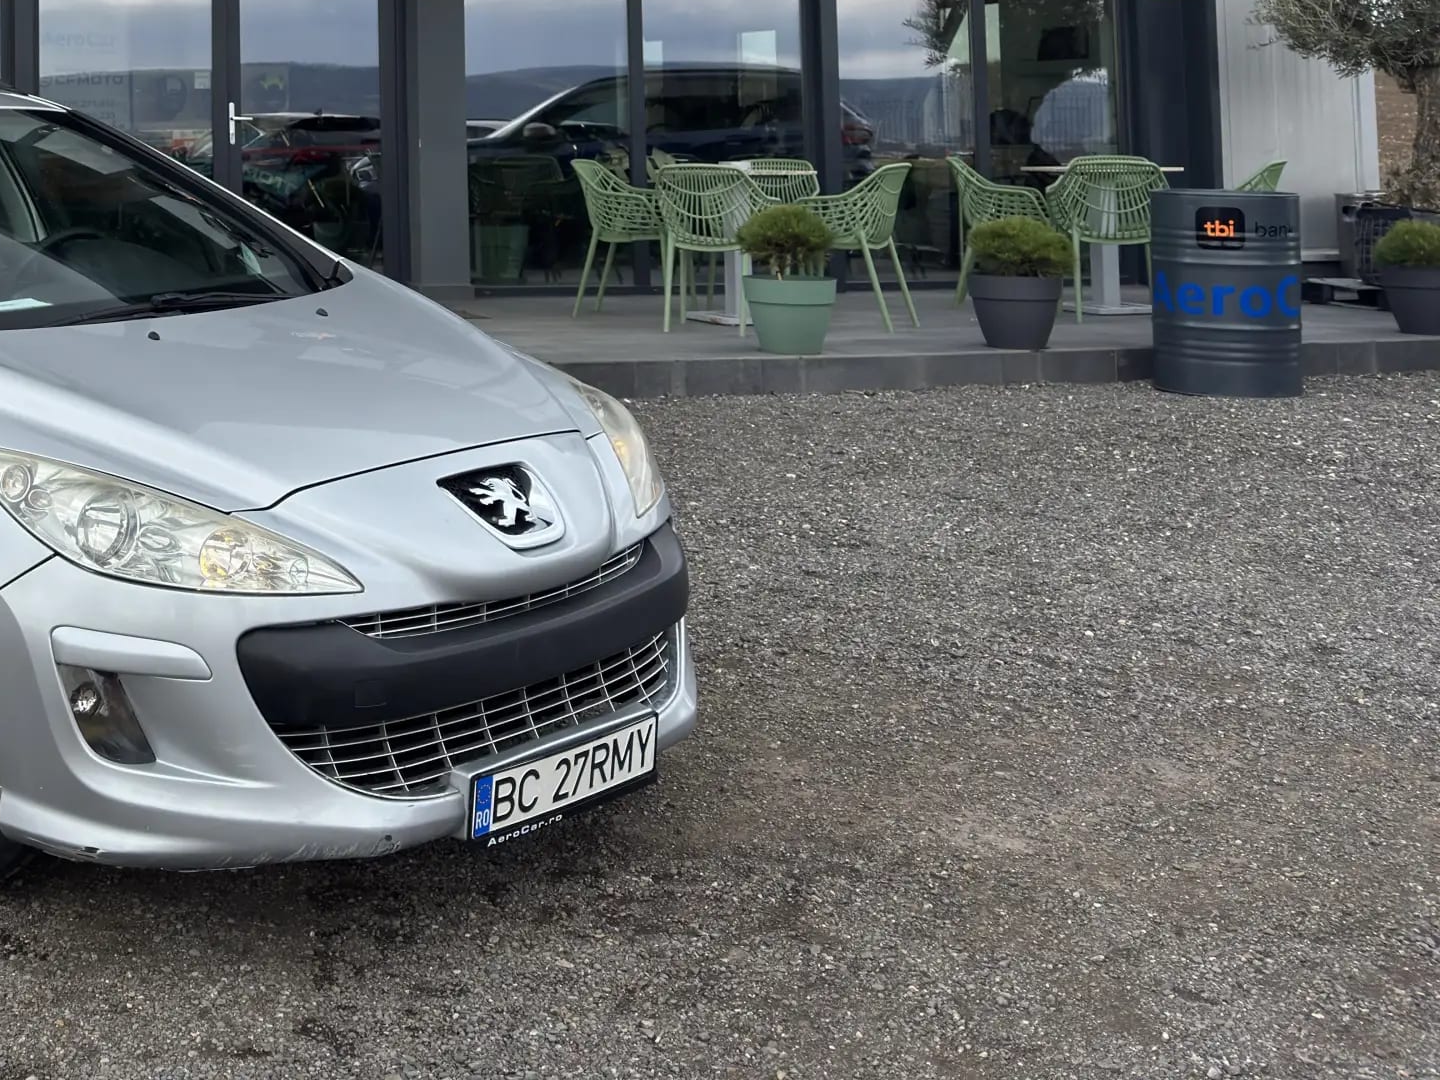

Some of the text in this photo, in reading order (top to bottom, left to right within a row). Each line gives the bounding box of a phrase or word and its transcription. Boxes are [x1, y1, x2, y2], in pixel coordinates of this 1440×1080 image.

[1203, 219, 1235, 237] tbi
[492, 769, 540, 825] BC
[475, 808, 490, 831] RO
[487, 814, 563, 848] AeroCar.ro
